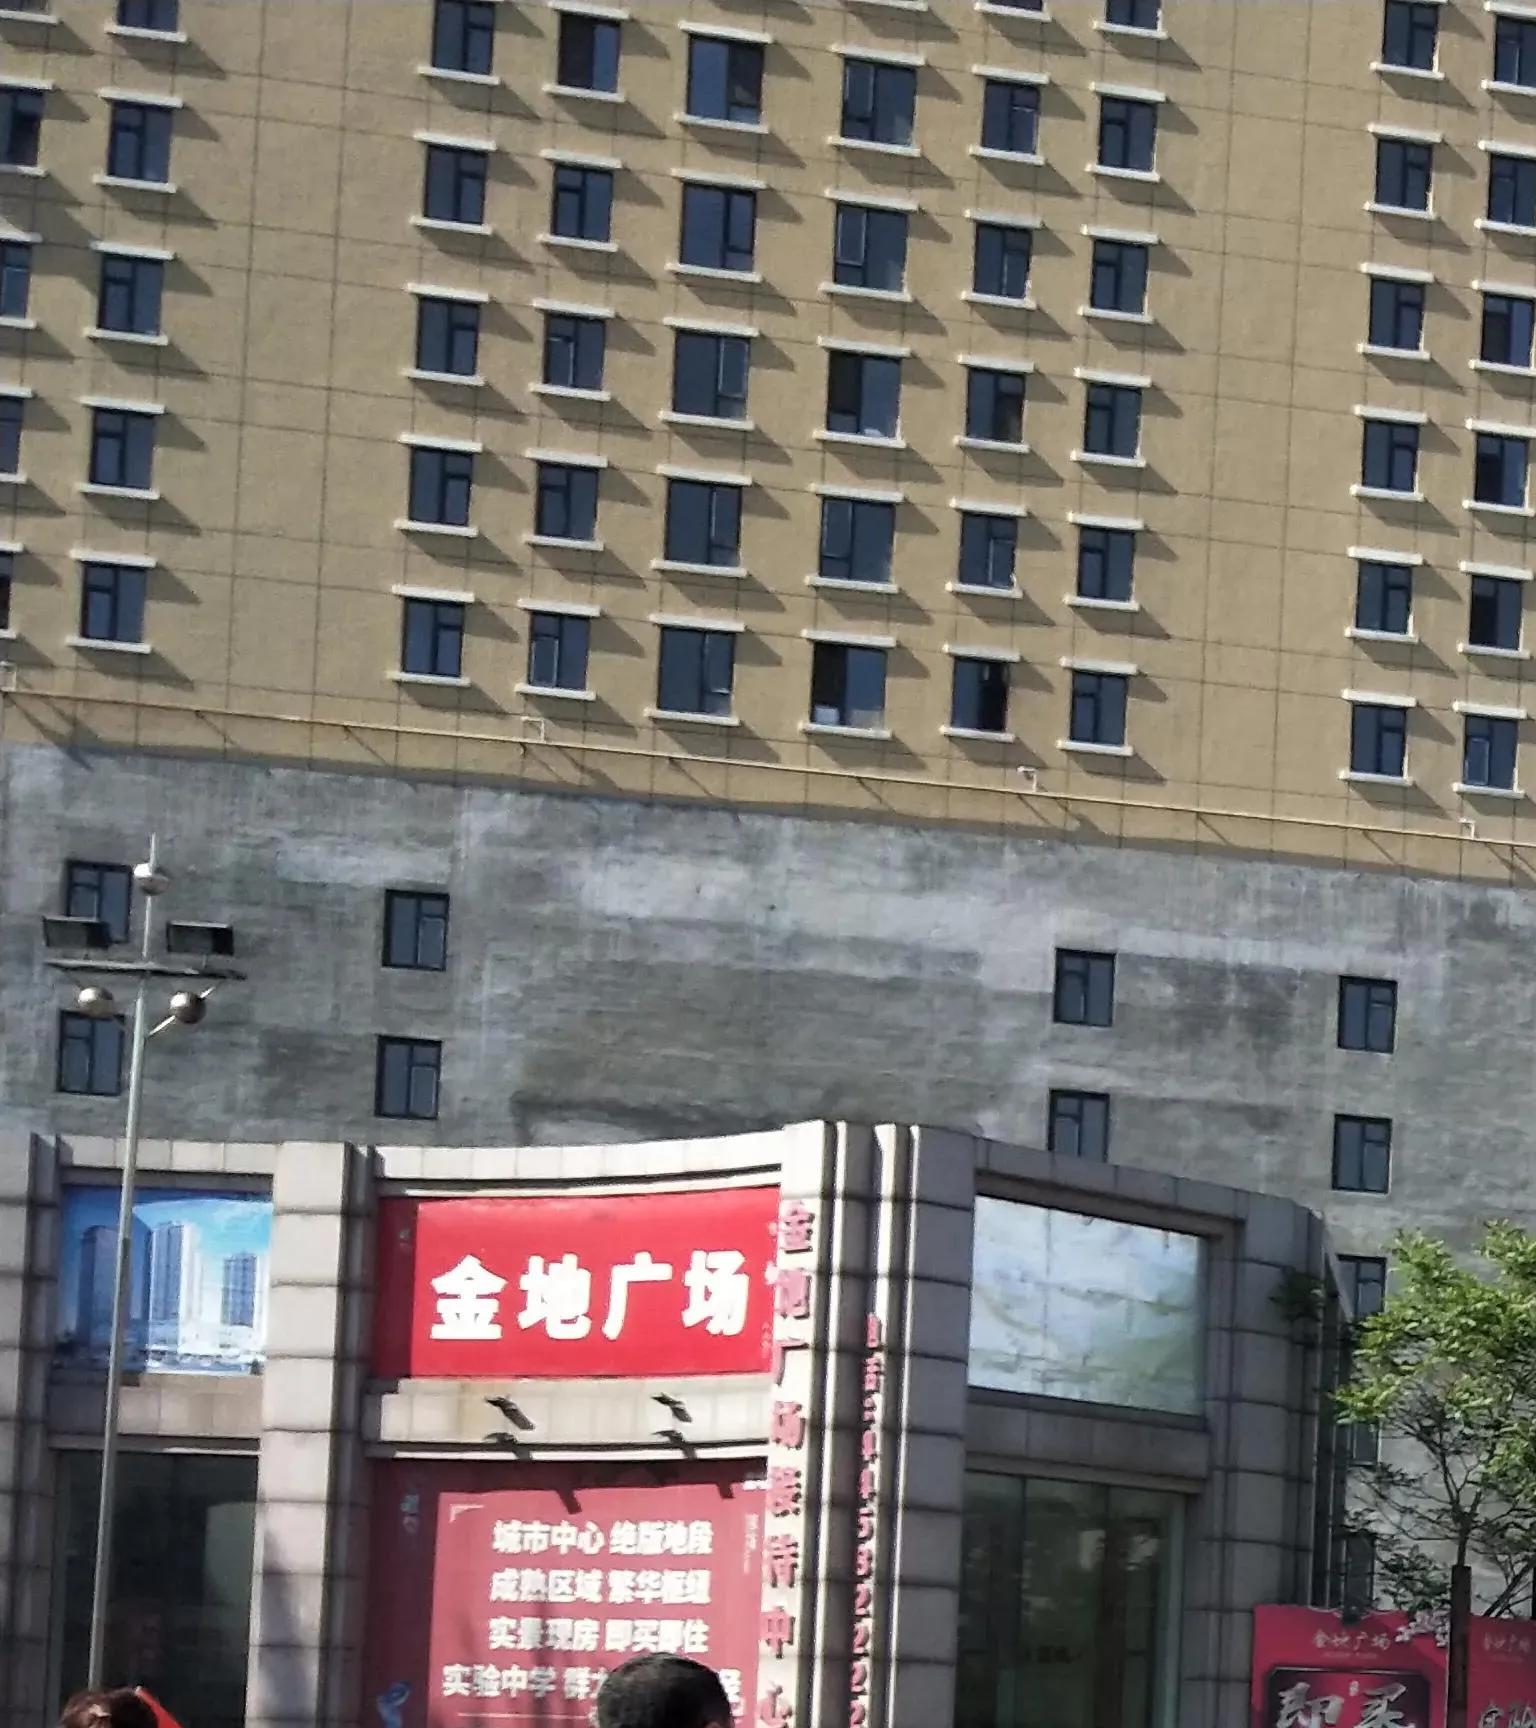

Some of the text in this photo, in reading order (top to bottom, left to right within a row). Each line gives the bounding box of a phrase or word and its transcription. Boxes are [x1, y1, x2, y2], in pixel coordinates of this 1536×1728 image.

[429, 1250, 751, 1341] 金地广场
[492, 1520, 605, 1555] 城市中心
[608, 1520, 714, 1555] 绝版地段
[489, 1567, 712, 1604] 成熟区域 繁华枢纽
[488, 1615, 710, 1653] 实景现房 即买即住
[441, 1664, 557, 1698] 实验中学
